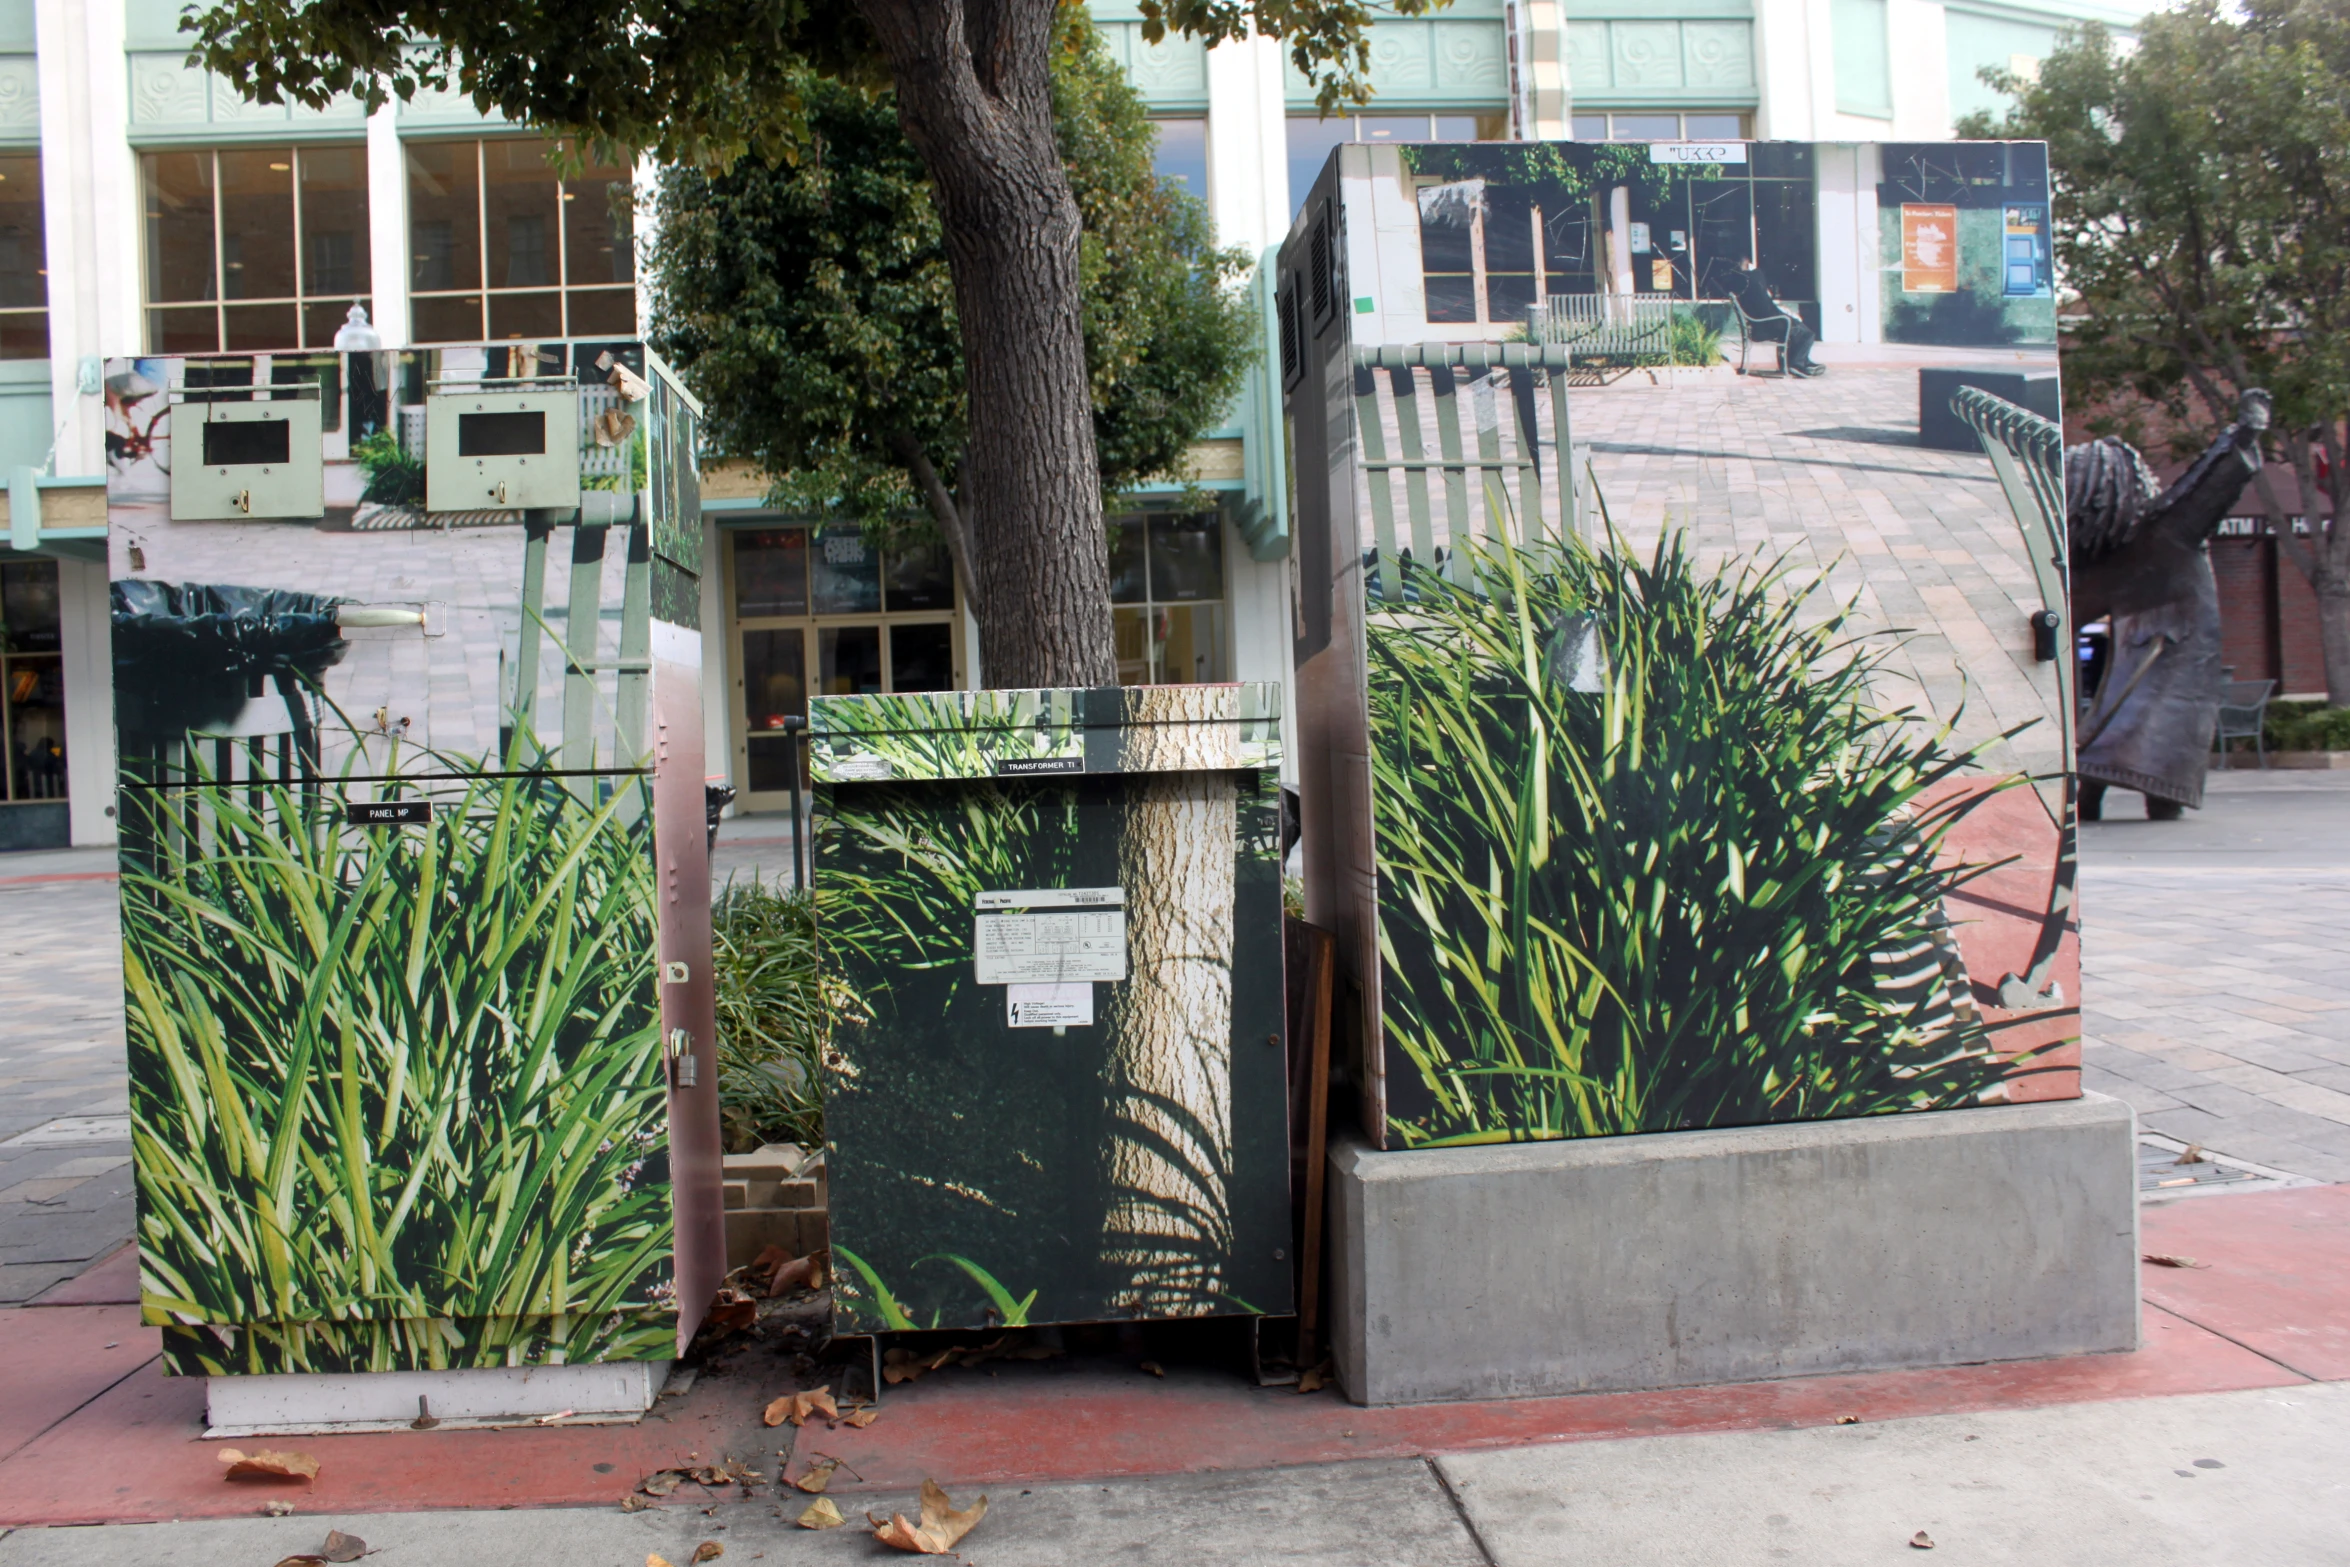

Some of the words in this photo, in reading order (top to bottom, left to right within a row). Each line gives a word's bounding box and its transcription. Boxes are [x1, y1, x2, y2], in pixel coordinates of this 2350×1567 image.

[2217, 517, 2255, 535] ATM
[1008, 762, 1064, 771] TRANSFORMER
[369, 809, 394, 818] PANEL
[397, 808, 409, 817] MP
